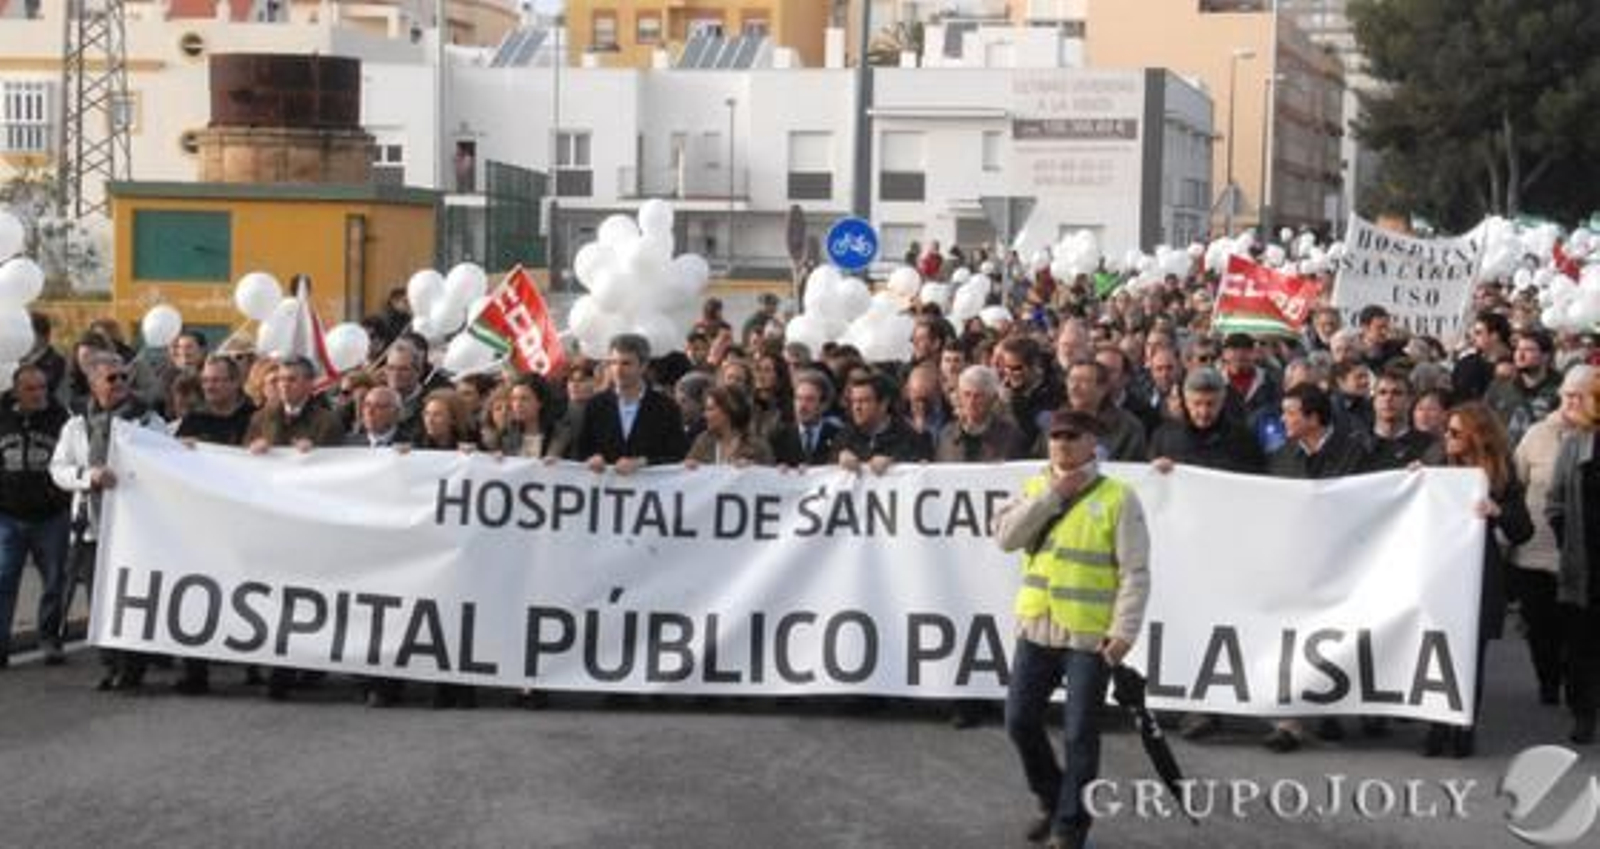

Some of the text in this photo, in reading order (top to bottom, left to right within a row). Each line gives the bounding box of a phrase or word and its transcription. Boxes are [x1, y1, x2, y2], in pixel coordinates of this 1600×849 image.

[435, 478, 698, 538] HOSPITAL
[713, 493, 782, 540] DE
[794, 486, 897, 537] SAN
[111, 566, 499, 675] HOSPITAL
[523, 586, 879, 683] PÚBLICO
[1146, 621, 1250, 702] LA
[1276, 628, 1463, 711] ISLA
